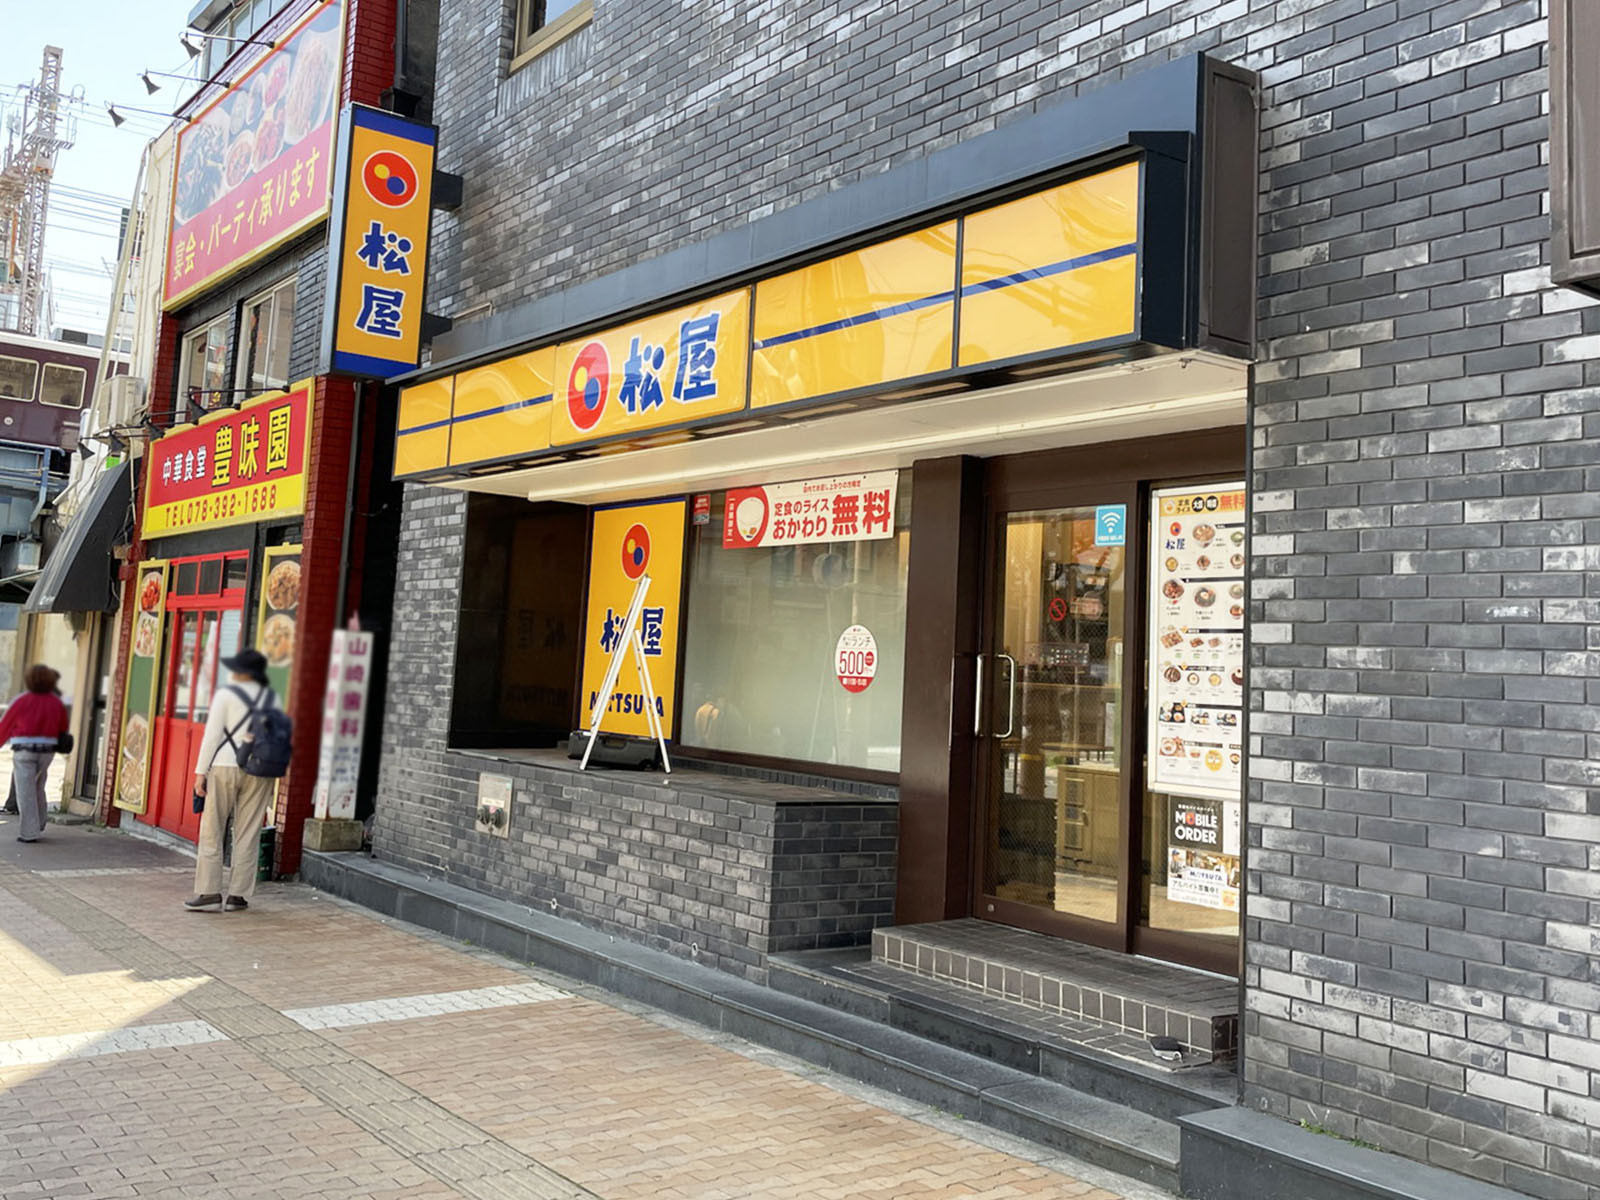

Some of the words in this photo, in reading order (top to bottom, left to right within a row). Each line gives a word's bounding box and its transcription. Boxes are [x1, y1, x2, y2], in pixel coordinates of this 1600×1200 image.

[173, 146, 320, 281] 宴会・パーティ承ります
[355, 221, 413, 338] 松屋
[618, 312, 721, 413] 松屋
[162, 446, 207, 486] 中華食堂
[211, 403, 292, 488] 豊味園
[774, 498, 829, 517] 定食のライス
[831, 489, 891, 536] 無料
[773, 514, 827, 540] おかわり
[1166, 538, 1185, 550] 松屋
[840, 651, 864, 675] 500
[1175, 811, 1218, 828] MOBILE
[1175, 826, 1217, 844] ORDER
